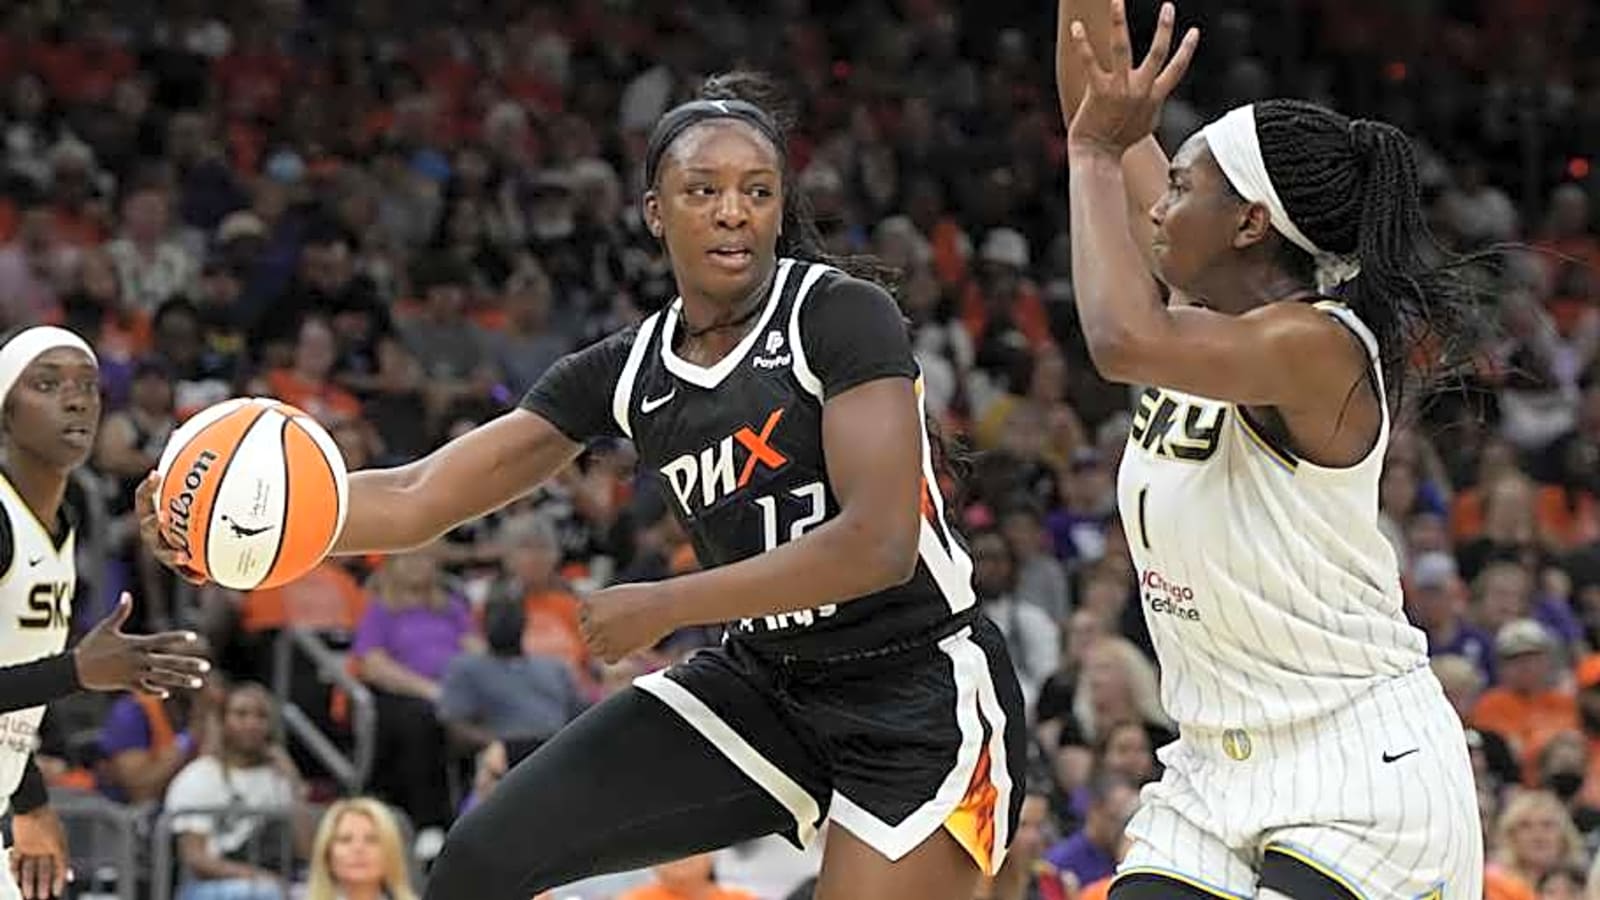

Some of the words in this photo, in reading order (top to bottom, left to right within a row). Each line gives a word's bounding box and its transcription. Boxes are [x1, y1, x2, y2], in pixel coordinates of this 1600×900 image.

[753, 353, 791, 370] PayPal
[754, 481, 826, 552] 12
[1138, 486, 1150, 549] 1
[19, 581, 73, 628] SK
